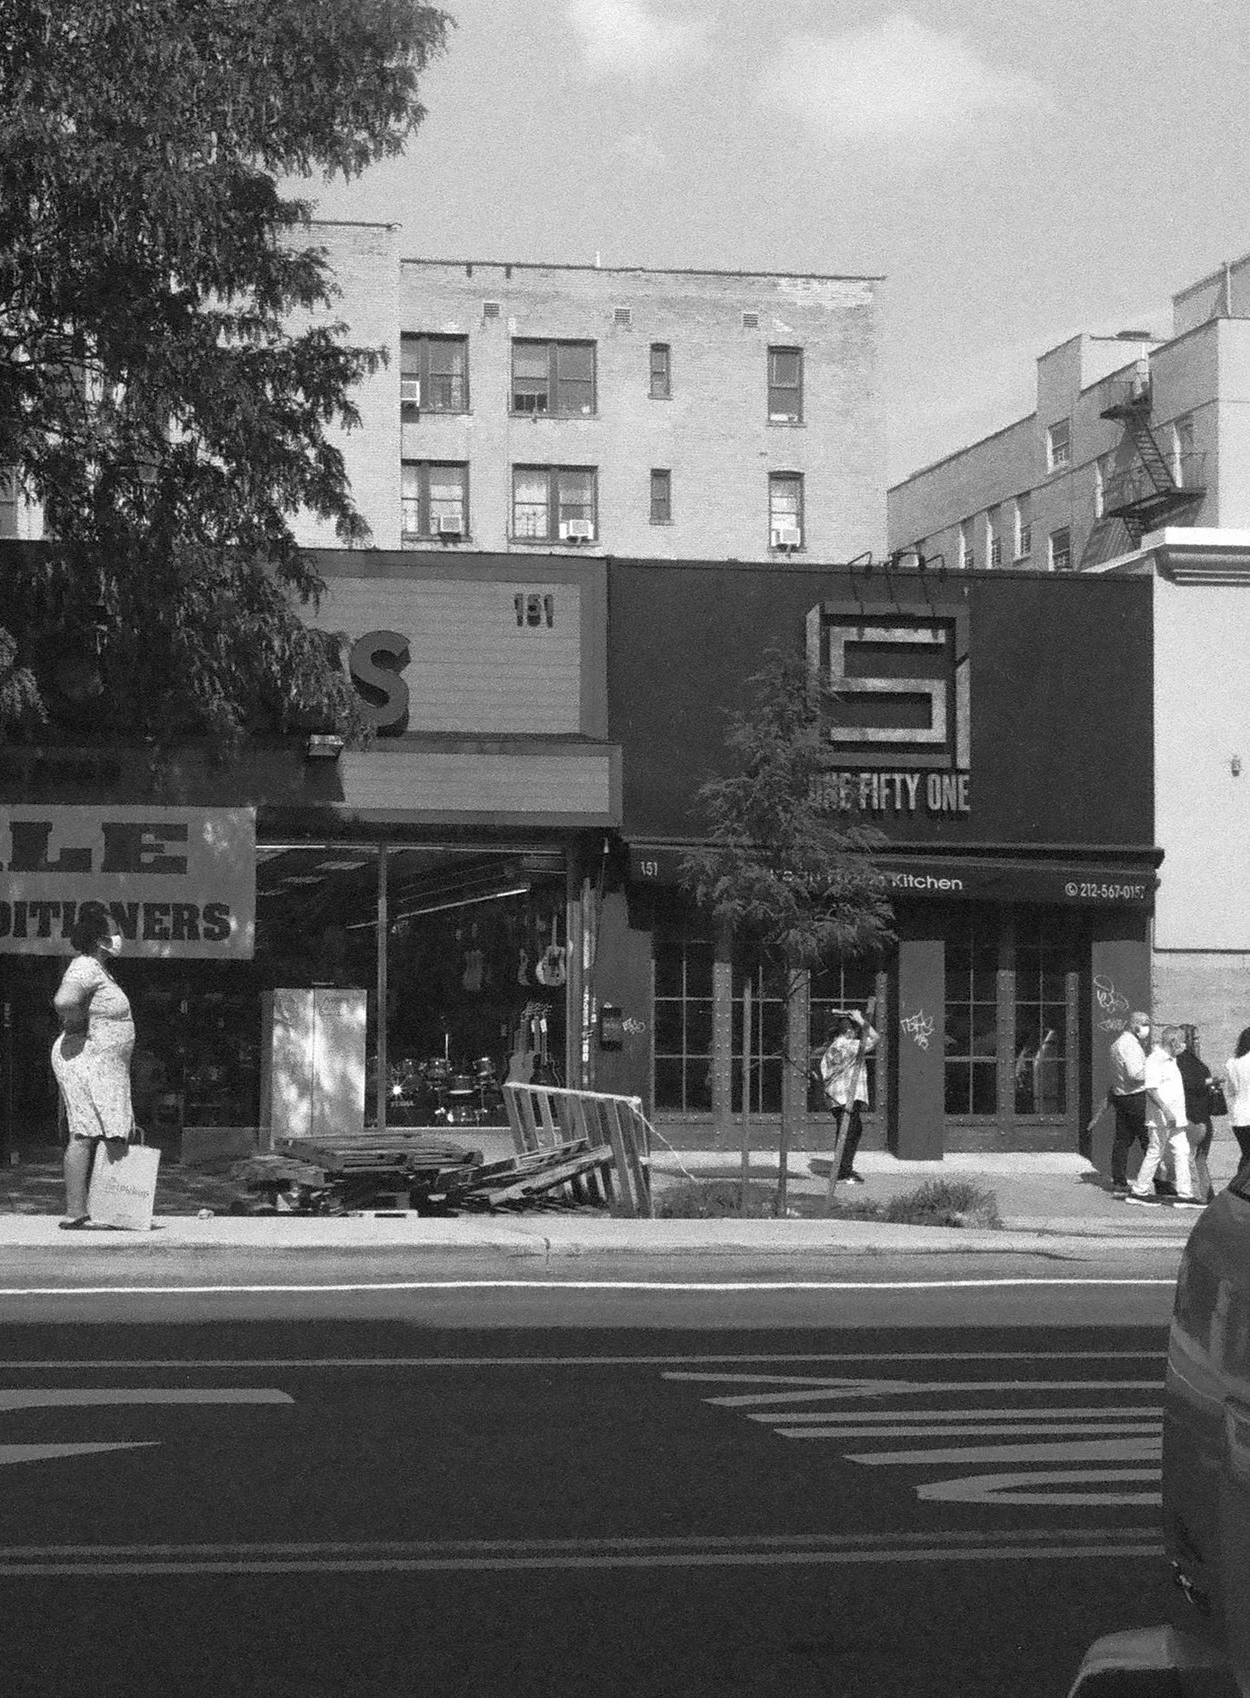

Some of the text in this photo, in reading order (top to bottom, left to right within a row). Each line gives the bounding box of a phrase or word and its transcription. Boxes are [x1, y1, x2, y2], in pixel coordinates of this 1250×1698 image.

[514, 593, 554, 628] 151
[859, 772, 920, 810] FIFTY
[927, 773, 971, 811] ONE
[640, 861, 658, 876] 151
[892, 873, 963, 890] Kitchen
